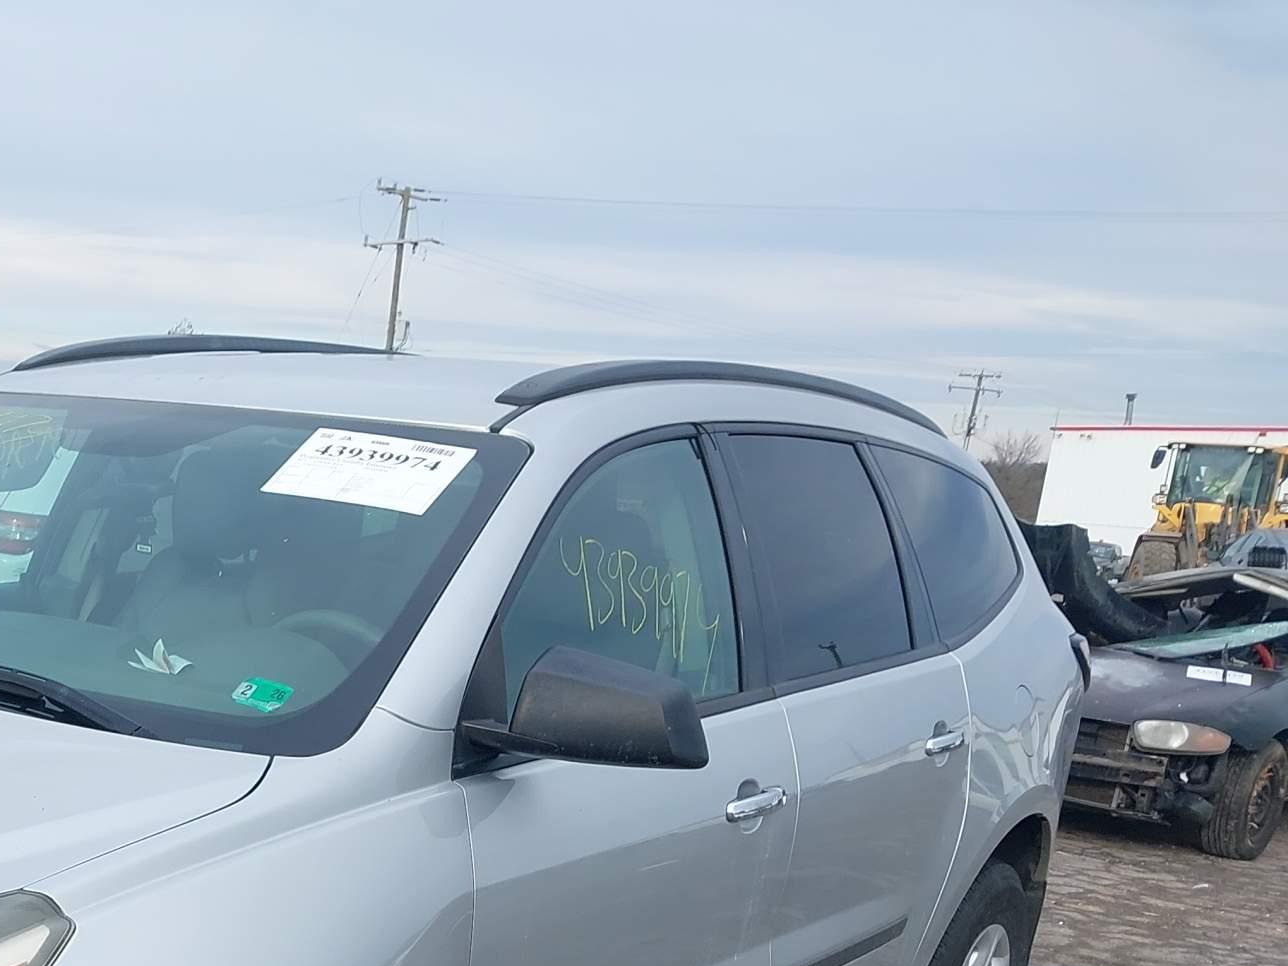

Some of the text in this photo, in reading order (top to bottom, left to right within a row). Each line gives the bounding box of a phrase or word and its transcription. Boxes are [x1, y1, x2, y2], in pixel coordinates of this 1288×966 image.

[315, 444, 442, 471] 43939974
[559, 535, 720, 697] 43939974
[240, 684, 253, 696] 2
